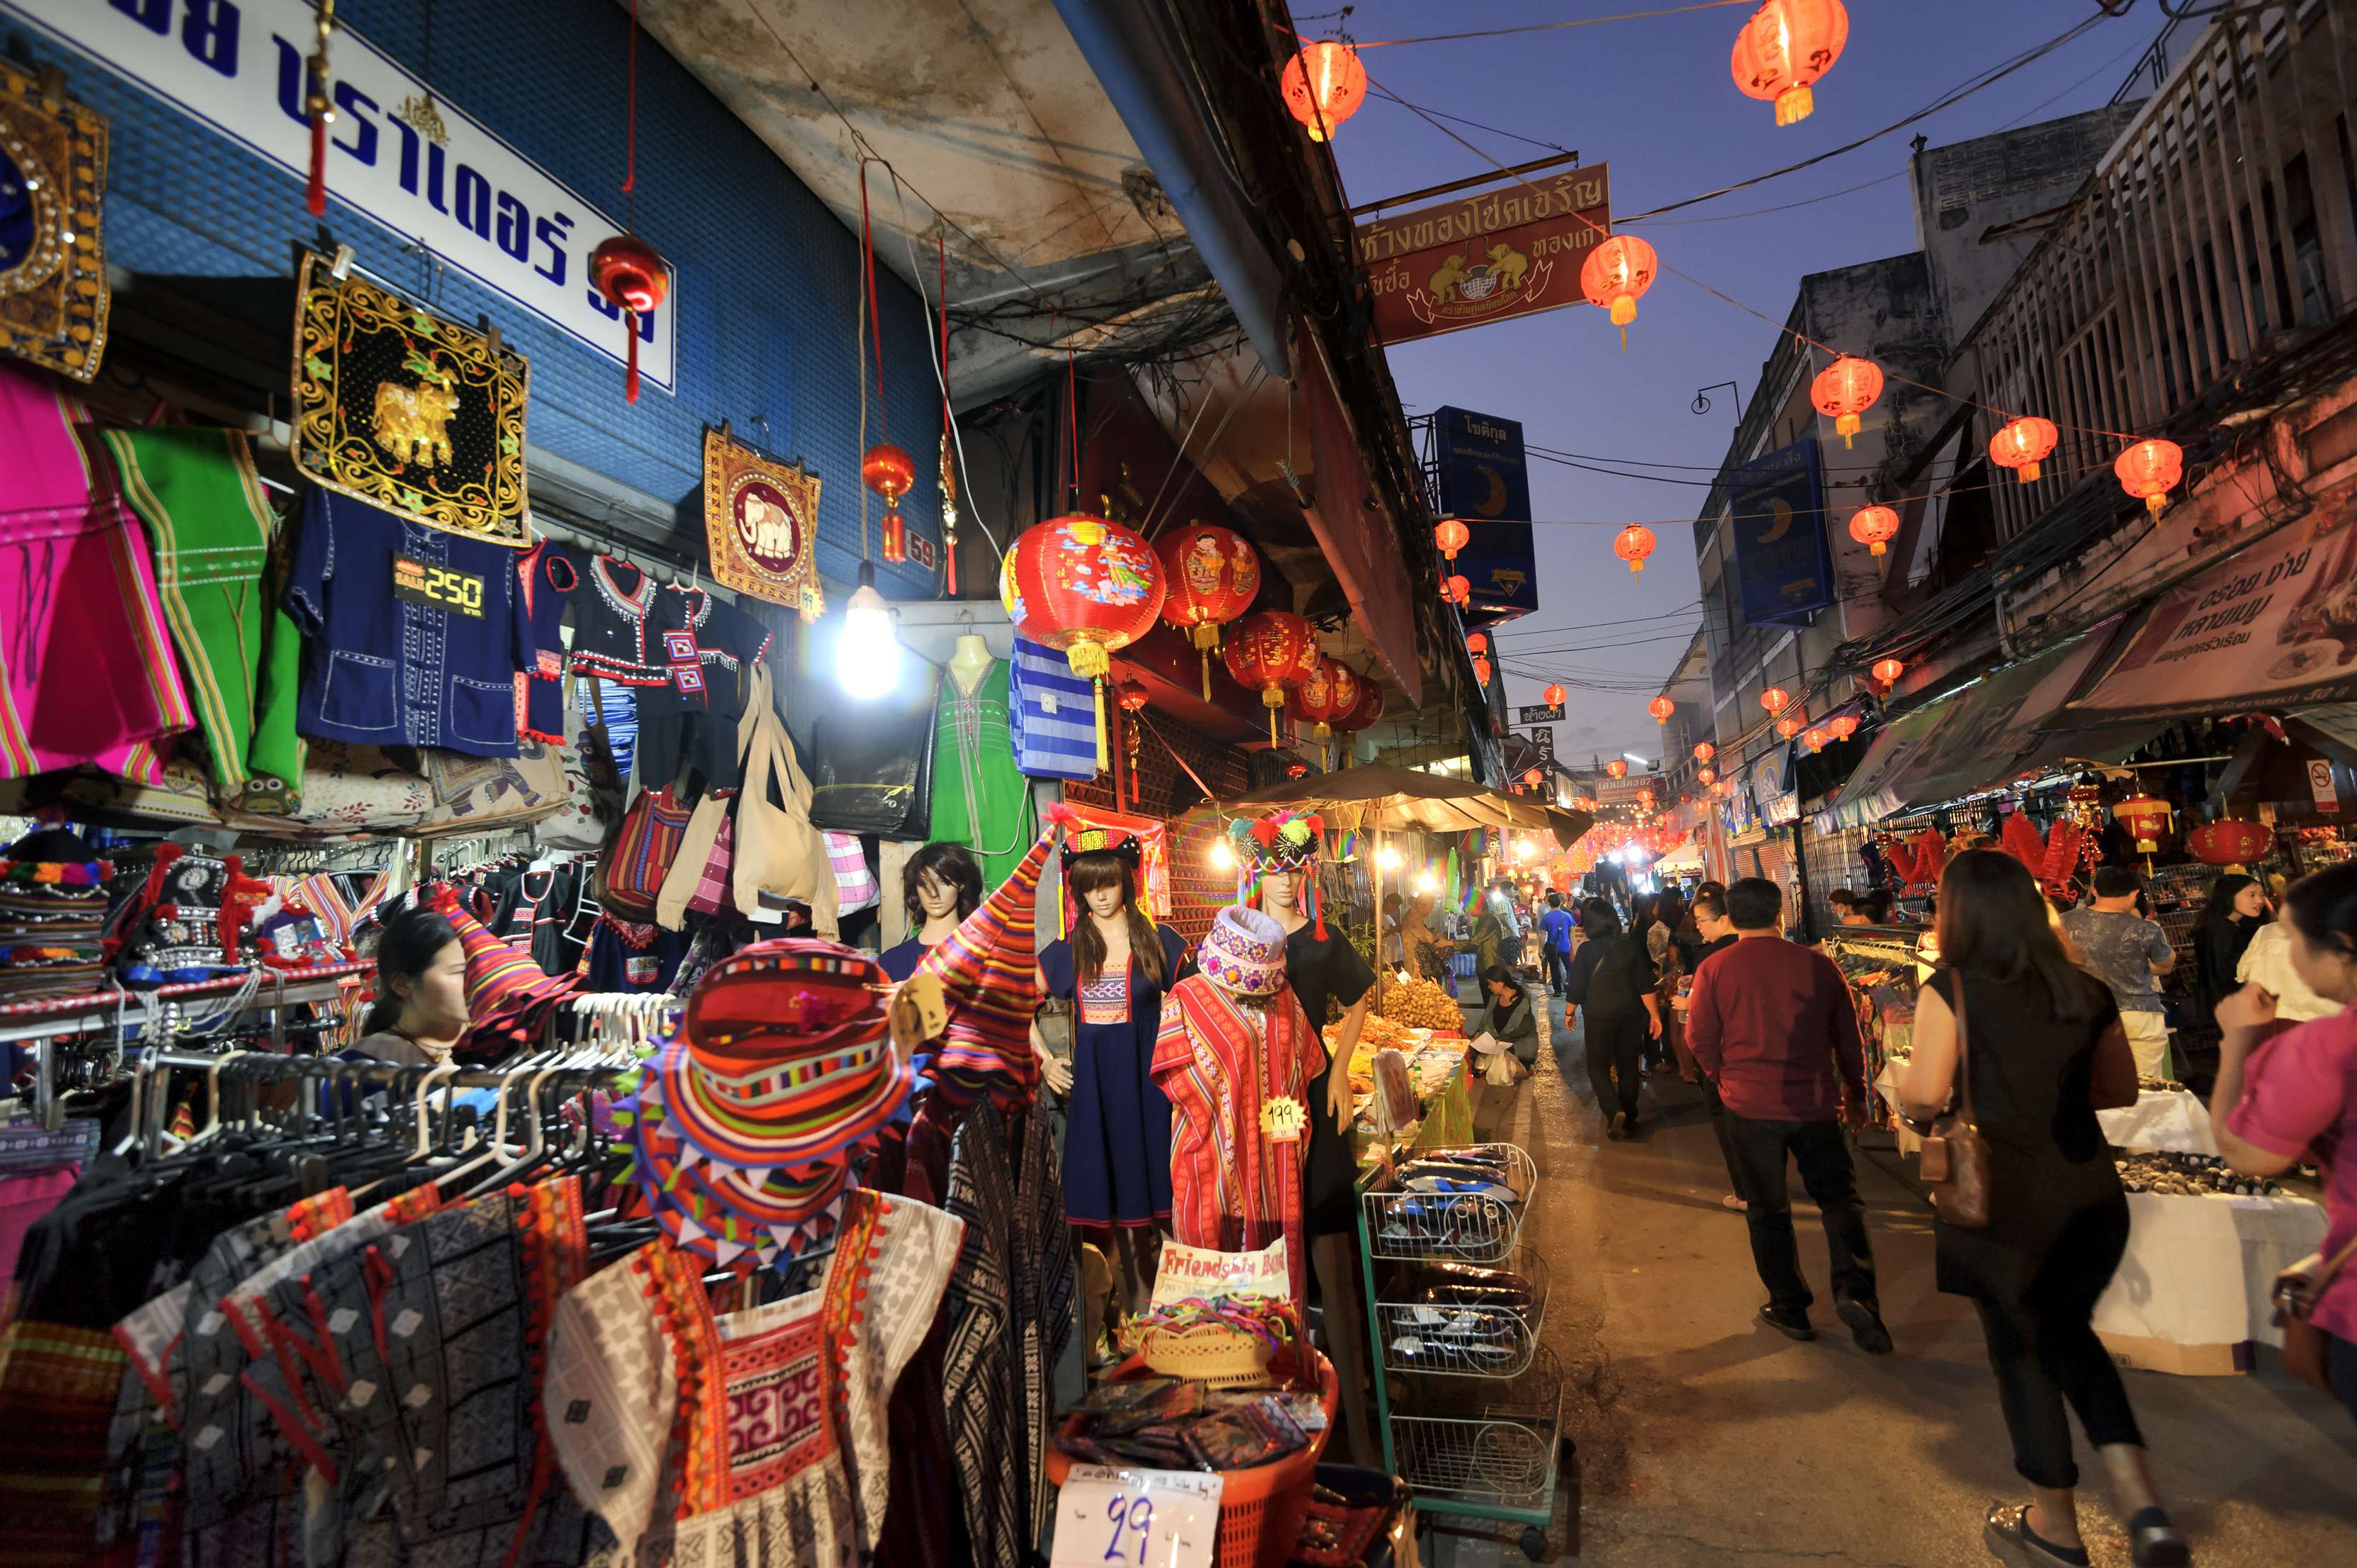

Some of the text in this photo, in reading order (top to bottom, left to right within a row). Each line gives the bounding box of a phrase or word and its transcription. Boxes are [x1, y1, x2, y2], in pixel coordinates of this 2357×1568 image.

[910, 532, 933, 568] 59
[394, 571, 425, 591] SALE
[424, 568, 482, 608] 250
[1268, 1104, 1293, 1126] 199
[1104, 1494, 1153, 1565] 29
